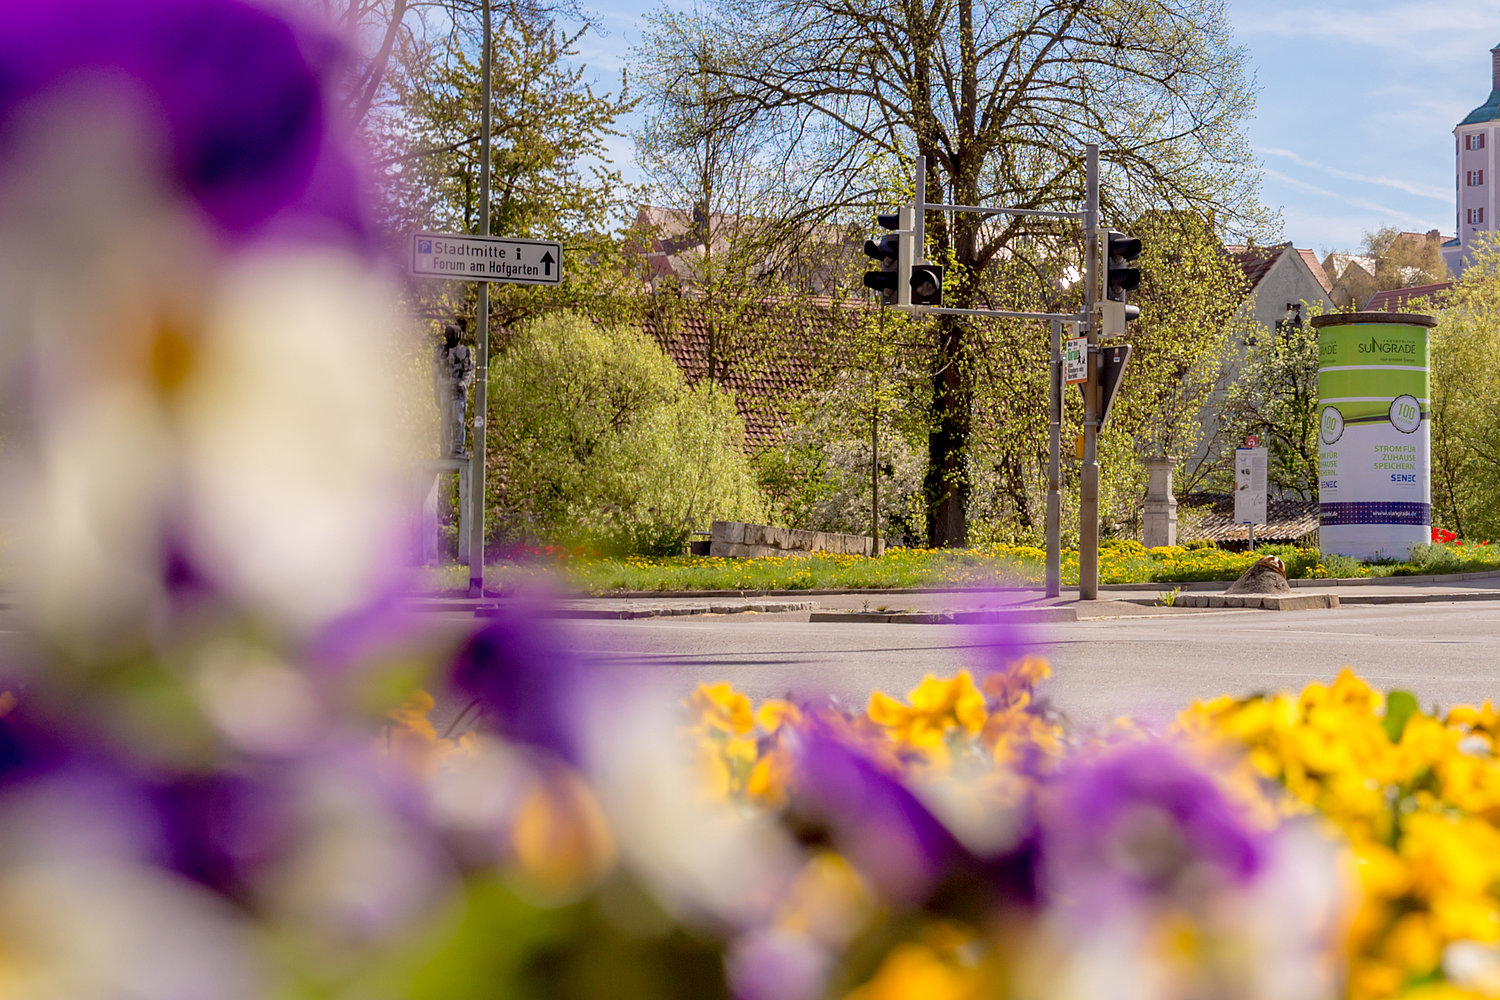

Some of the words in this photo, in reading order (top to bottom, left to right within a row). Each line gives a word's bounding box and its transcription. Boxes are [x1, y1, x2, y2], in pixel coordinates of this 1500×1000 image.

[434, 241, 506, 259] Stadtmitte
[433, 257, 466, 272] Forum
[470, 261, 485, 273] am
[489, 261, 539, 277] Hofgarten
[1358, 336, 1416, 354] SUNGRADE
[1398, 402, 1415, 420] 100
[1374, 445, 1401, 453] STROM
[1403, 445, 1417, 453] FÜR
[1382, 454, 1417, 462] ZUHAUSE
[1391, 474, 1416, 483] SENEC
